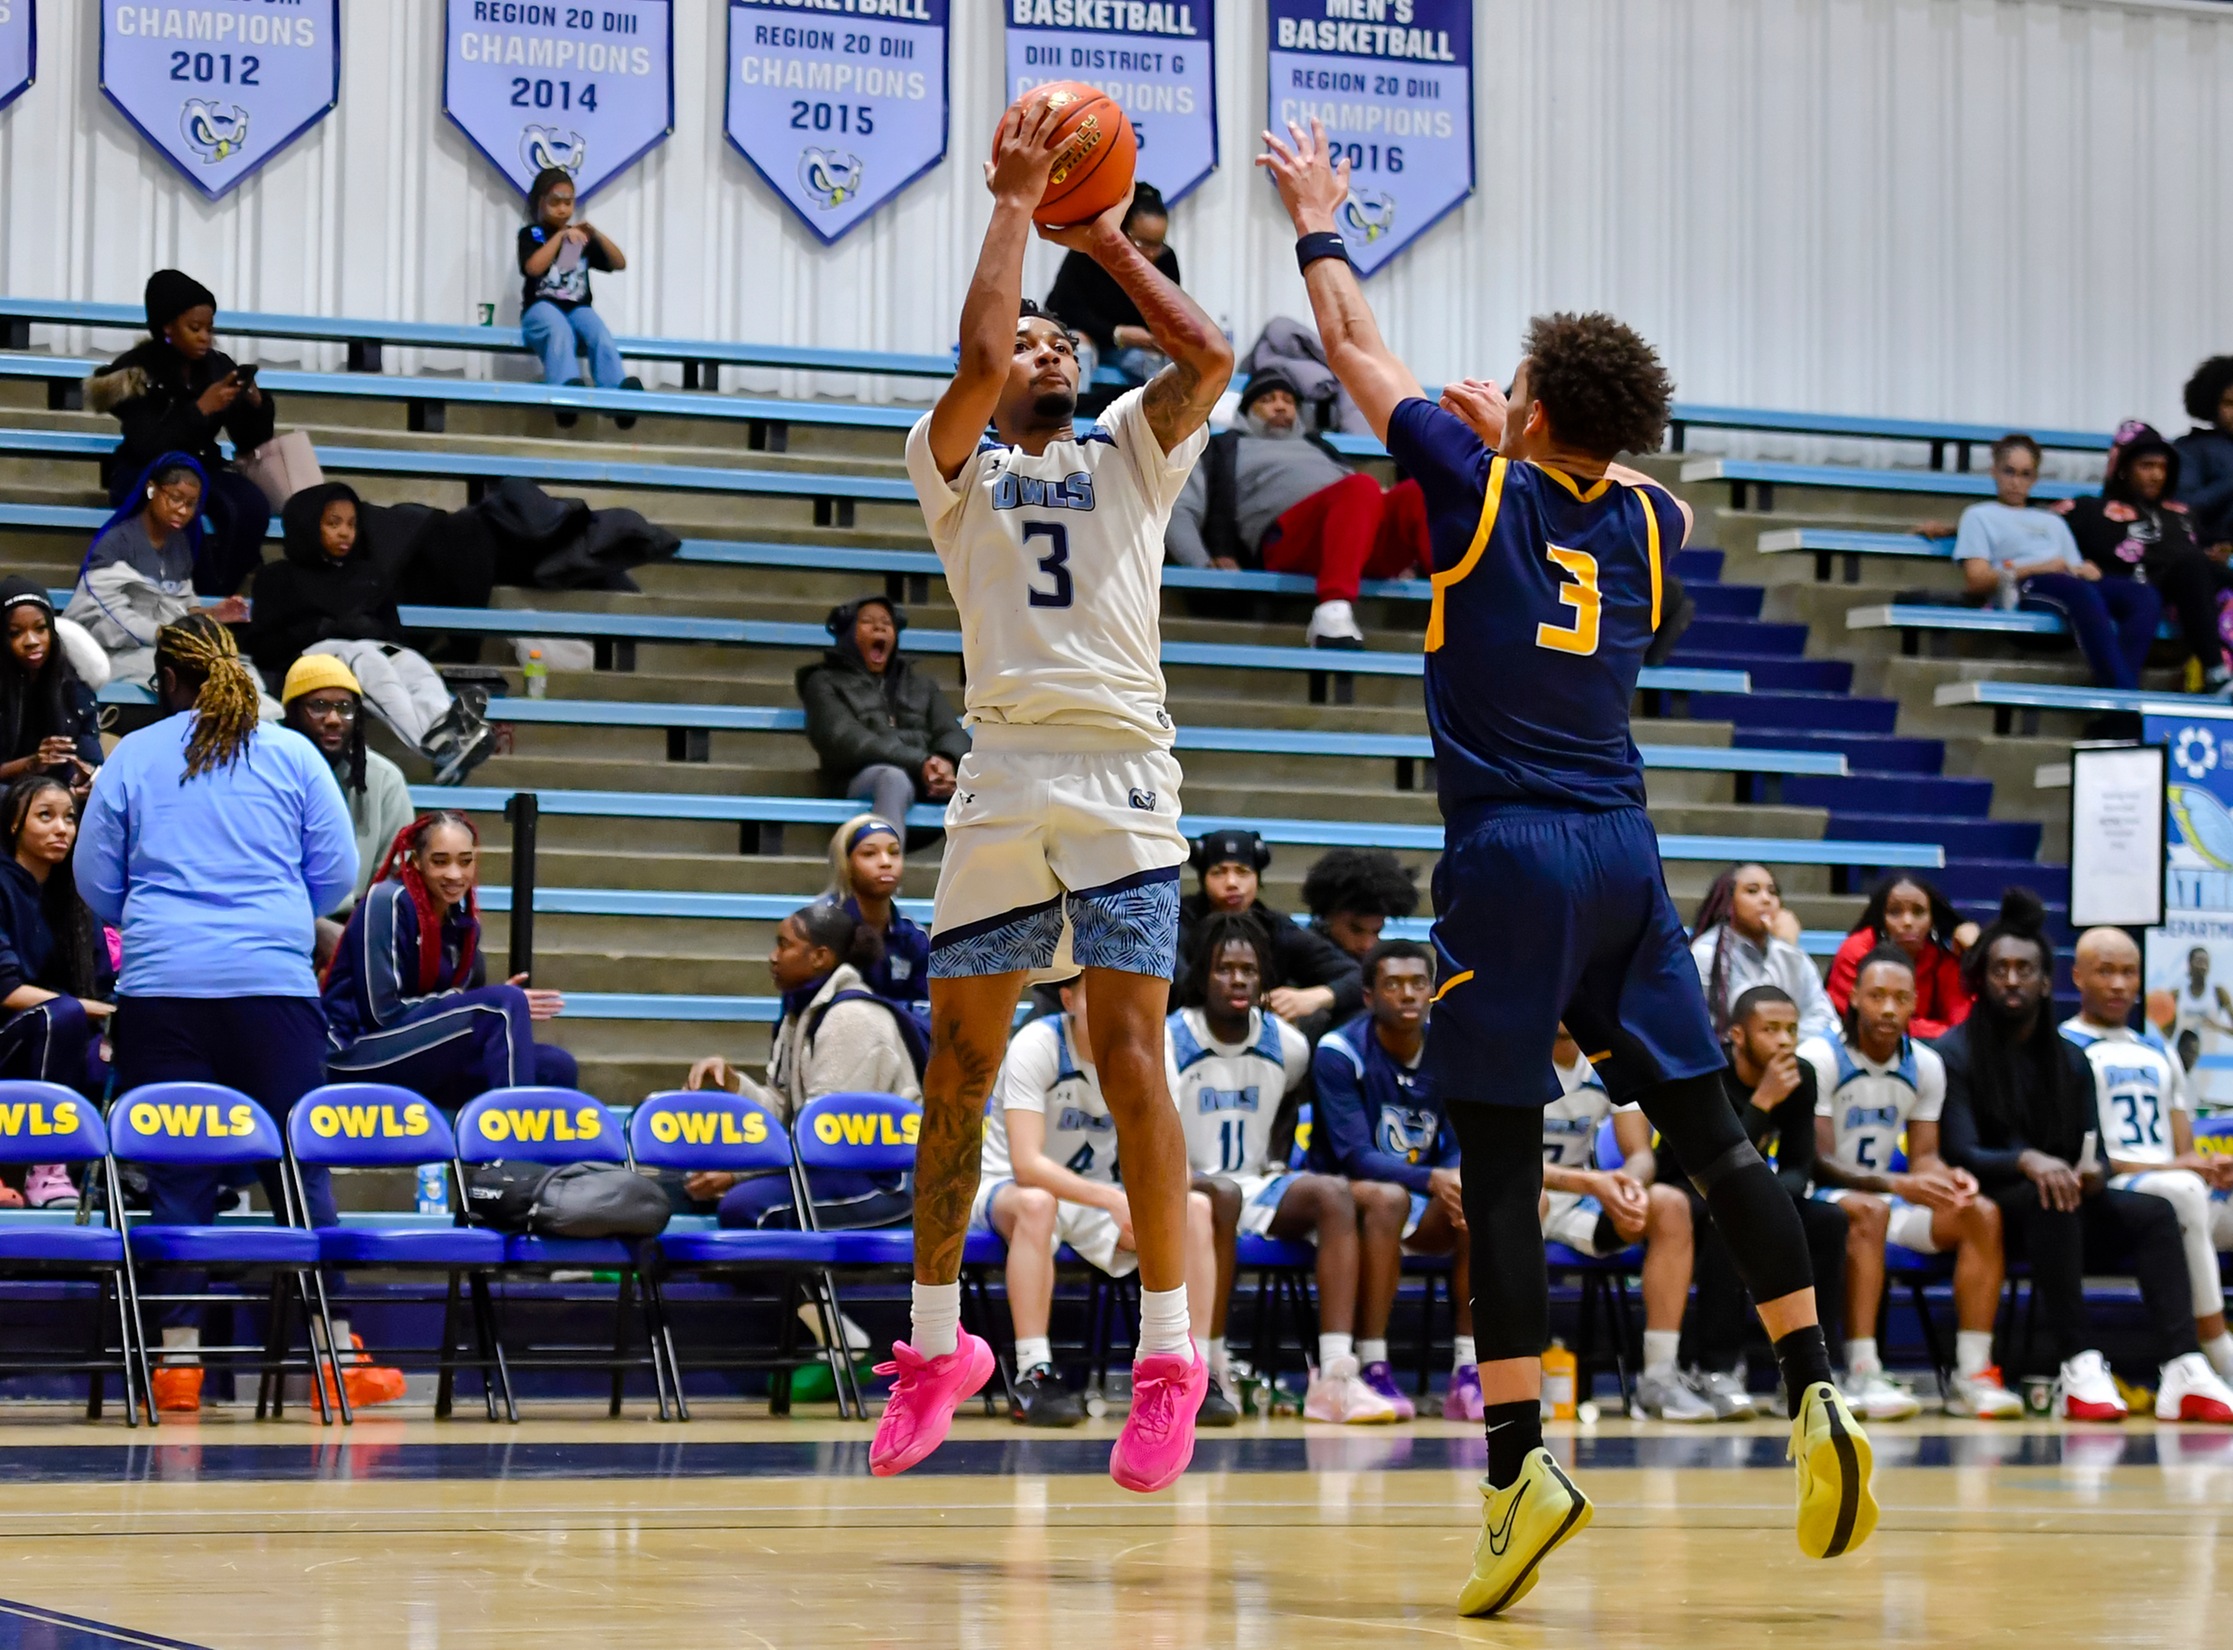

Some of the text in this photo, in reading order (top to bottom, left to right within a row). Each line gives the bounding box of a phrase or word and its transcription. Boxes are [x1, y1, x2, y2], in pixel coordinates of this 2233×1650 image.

[116, 5, 314, 47] CHAMPIONS
[474, 1, 637, 34] REGION 20 DIII
[1013, 0, 1197, 35] BASKETBALL
[460, 32, 651, 76] CHAMPIONS
[756, 25, 913, 59] REGION 20 DIII
[1278, 17, 1455, 61] BASKETBALL
[170, 51, 260, 86] 2012
[1026, 46, 1184, 73] DIII DISTRICT G
[510, 77, 598, 112] 2014
[741, 56, 925, 100] CHAMPIONS
[1017, 77, 1195, 114] CPIONS
[1292, 69, 1439, 99] REGION 20 DIII
[791, 101, 874, 135] 2015
[1281, 98, 1453, 138] CHAMPIONS
[1329, 142, 1404, 173] 2016
[992, 471, 1096, 512] OWLS
[1022, 520, 1075, 609] 3
[1535, 541, 1603, 657] 3
[0, 1102, 80, 1136] WLS
[129, 1102, 256, 1137] OWLS
[309, 1103, 430, 1138] OWLS
[478, 1108, 601, 1142] OWLS
[650, 1111, 768, 1144] OWLS
[813, 1113, 922, 1145] OWLS
[2111, 1094, 2164, 1145] 32
[1220, 1119, 1246, 1171] 11
